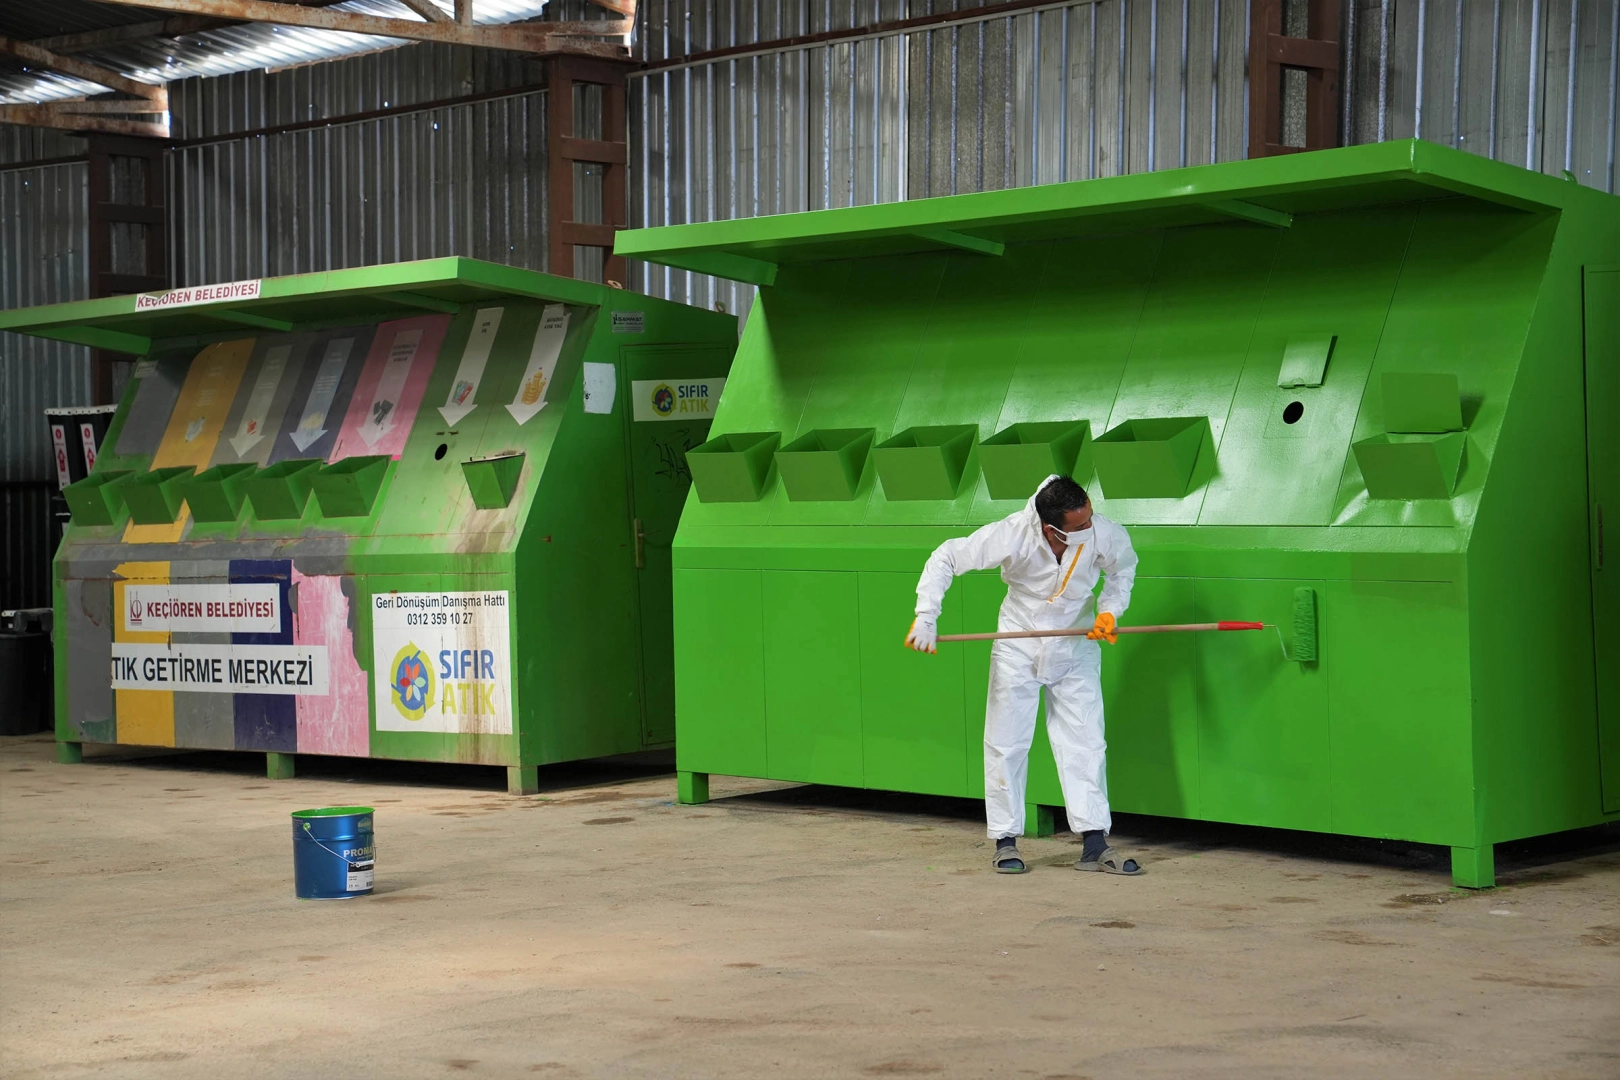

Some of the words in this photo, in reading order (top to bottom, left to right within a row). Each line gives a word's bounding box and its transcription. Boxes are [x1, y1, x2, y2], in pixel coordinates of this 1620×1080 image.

[195, 280, 259, 301] BELEDİYESİ
[678, 384, 709, 399] SIFIR
[679, 399, 709, 413] ATIK
[147, 598, 203, 619] KEÇİÖREN
[206, 598, 274, 618] BELEDİYESİ
[376, 597, 394, 608] Geri
[396, 596, 440, 610] Dönüşüm
[442, 595, 482, 609] Danışma
[484, 595, 505, 607] Hattı
[407, 613, 429, 625] 0312
[431, 613, 447, 625] 359
[450, 613, 461, 624] 10
[463, 612, 473, 624] 27
[143, 653, 222, 683] GETİRME
[229, 654, 313, 686] MERKEZİ
[439, 649, 495, 679] SIFIR
[443, 683, 496, 715] ATIK
